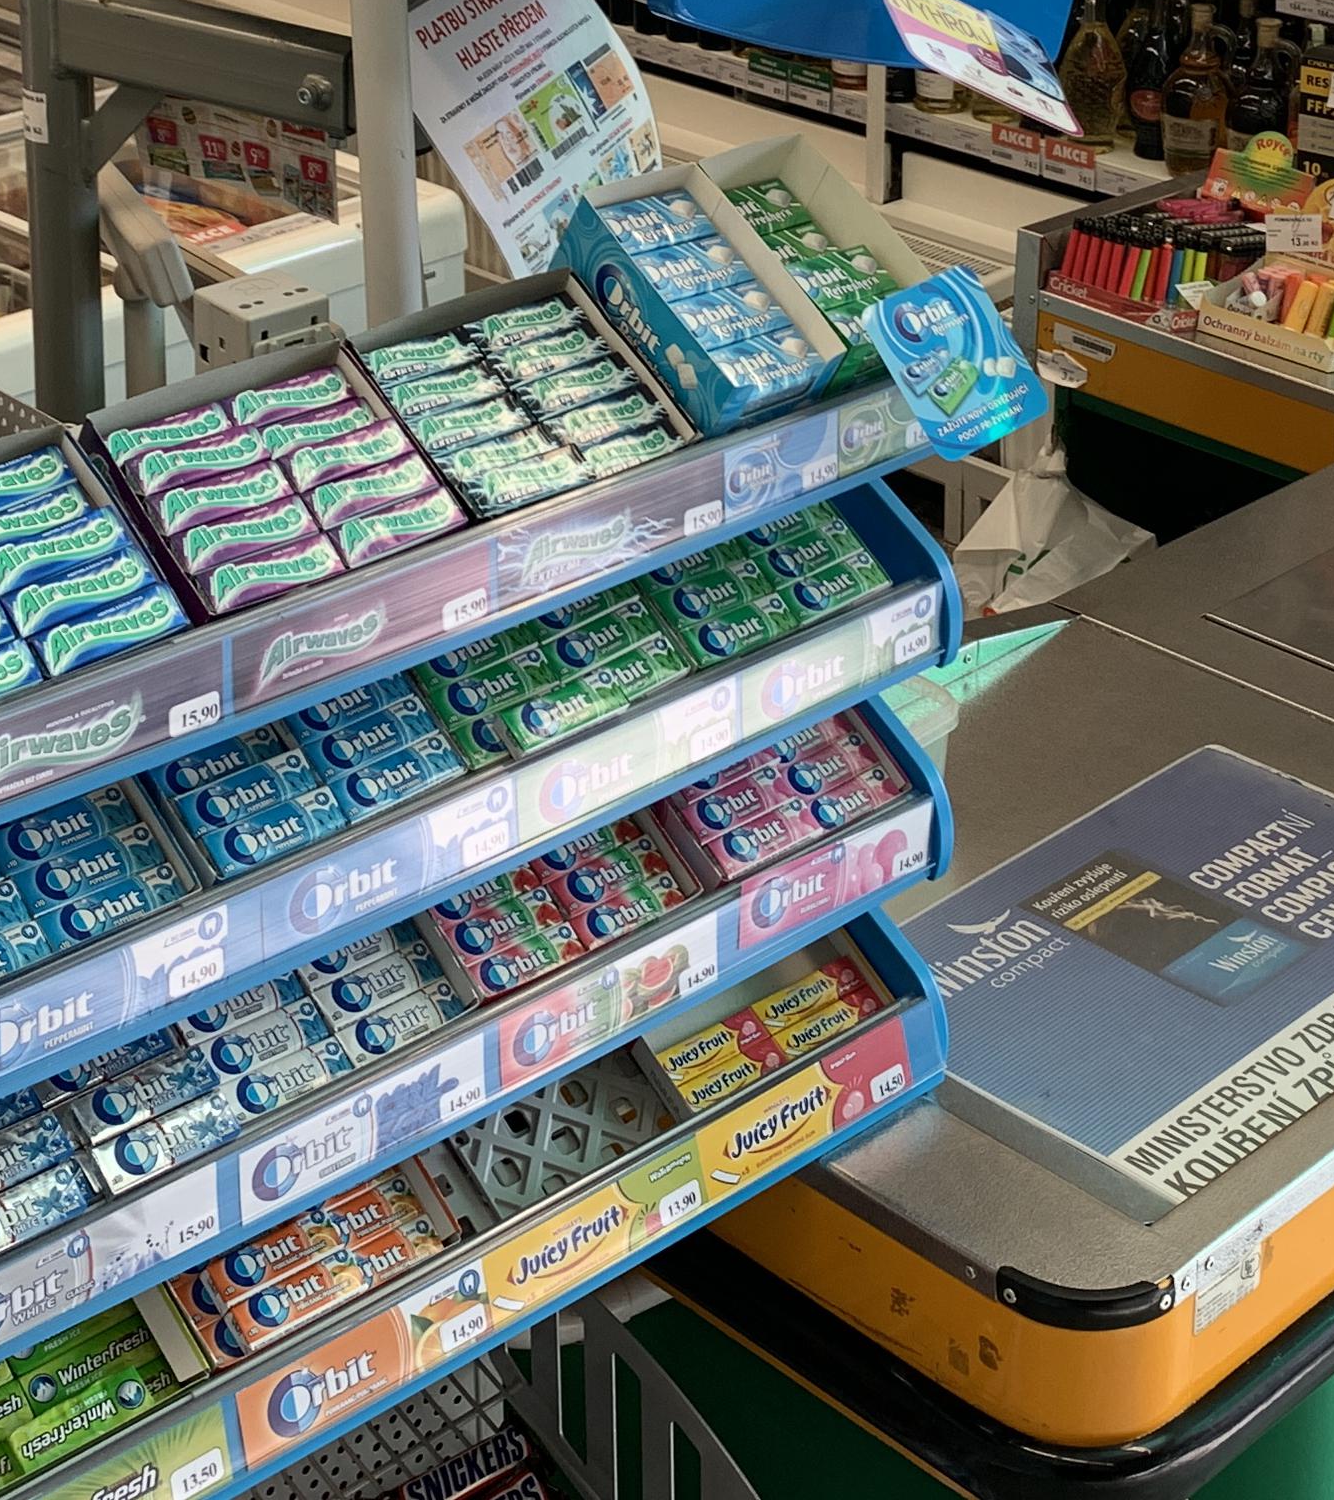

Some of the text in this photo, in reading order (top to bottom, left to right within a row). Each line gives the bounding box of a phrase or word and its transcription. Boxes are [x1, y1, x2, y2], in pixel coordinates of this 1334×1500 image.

[416, 2, 470, 50] PLATBU
[455, 0, 548, 71] HLASTE PŘEDEM
[998, 128, 1033, 149] AKCE
[1052, 143, 1088, 164] AKCE
[1303, 160, 1322, 176] 10
[1049, 275, 1088, 300] Cricket
[1202, 315, 1254, 341] Ochranný
[1254, 330, 1292, 352] balzám
[142, 433, 258, 485] Airwaves
[213, 548, 330, 605] Airwaves
[450, 593, 488, 624] 15,90
[901, 634, 929, 656] 14,90
[178, 700, 219, 730] 15,90
[898, 851, 925, 871] 14,90
[1188, 806, 1317, 891] COMPACTNÍ
[989, 934, 1071, 991] compact
[1207, 931, 1275, 974] Winston
[178, 960, 219, 990] 14,90
[686, 963, 716, 989] 14,90
[799, 979, 830, 1007] Fruit
[42, 1019, 96, 1050] PEPPERMINT
[667, 1047, 699, 1075] Juicy
[448, 1086, 482, 1113] 14,90
[876, 1071, 904, 1097] 14,50
[730, 1086, 827, 1161] Juicy Fruit
[1123, 1044, 1305, 1178] MINISTERSTVO
[1162, 1087, 1298, 1202] KOUŘENÍ
[667, 1191, 698, 1218] 13,90
[176, 1215, 215, 1246] 15,90
[515, 1204, 623, 1286] Juicy Fruit
[11, 1295, 58, 1326] WHITE
[450, 1315, 485, 1343] 14,90
[56, 1327, 152, 1387] Winterfresh
[267, 1349, 378, 1439] Orbit
[180, 1461, 219, 1492] 13,50
[406, 1428, 527, 1499] SNICKERS
